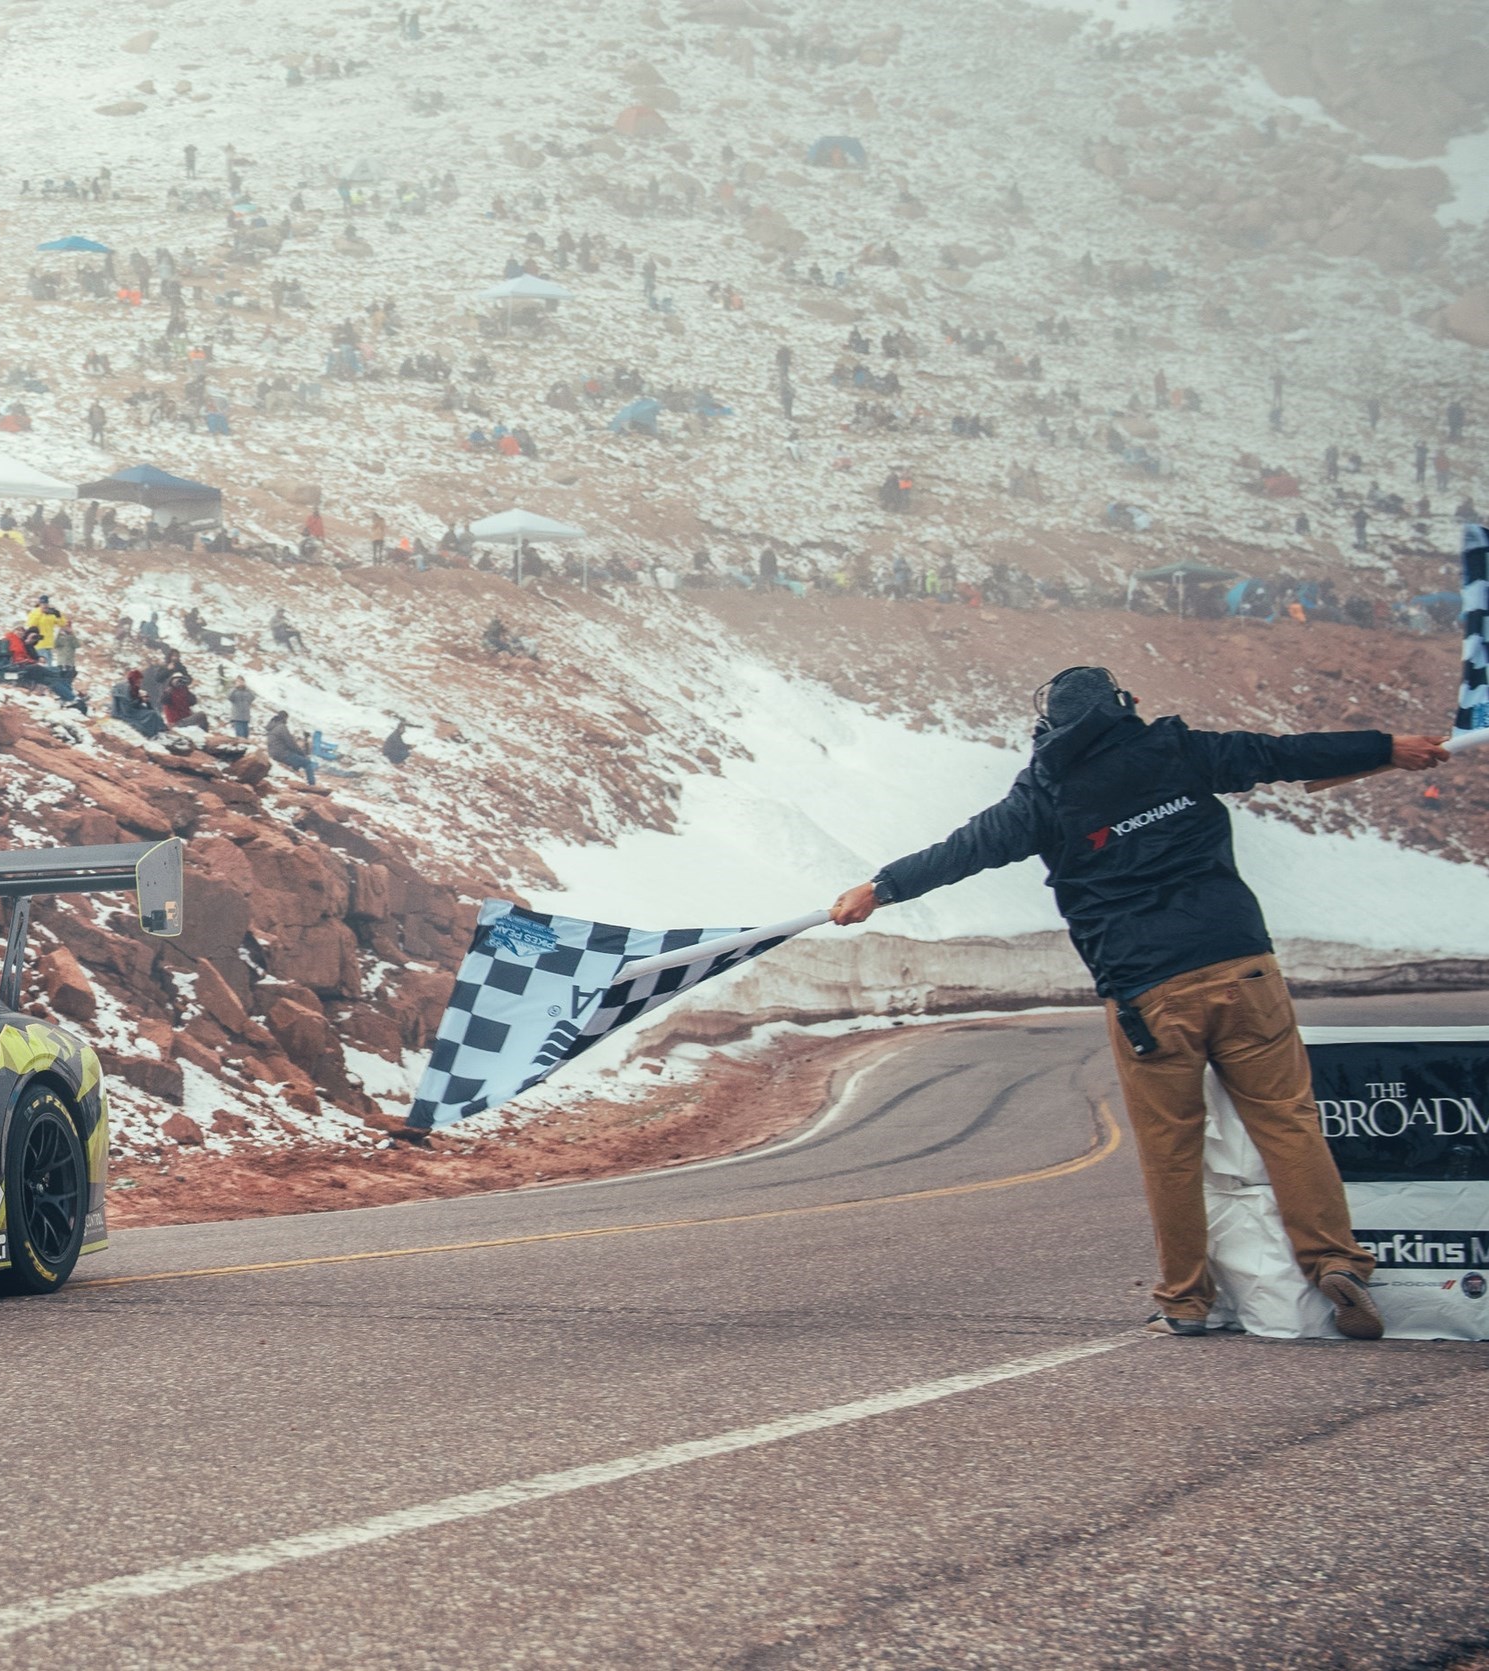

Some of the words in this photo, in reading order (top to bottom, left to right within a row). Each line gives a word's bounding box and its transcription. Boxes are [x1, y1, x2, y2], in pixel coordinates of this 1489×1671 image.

[494, 924, 523, 940] PEAK
[524, 933, 556, 950] PIKES
[1365, 1082, 1408, 1098] THE
